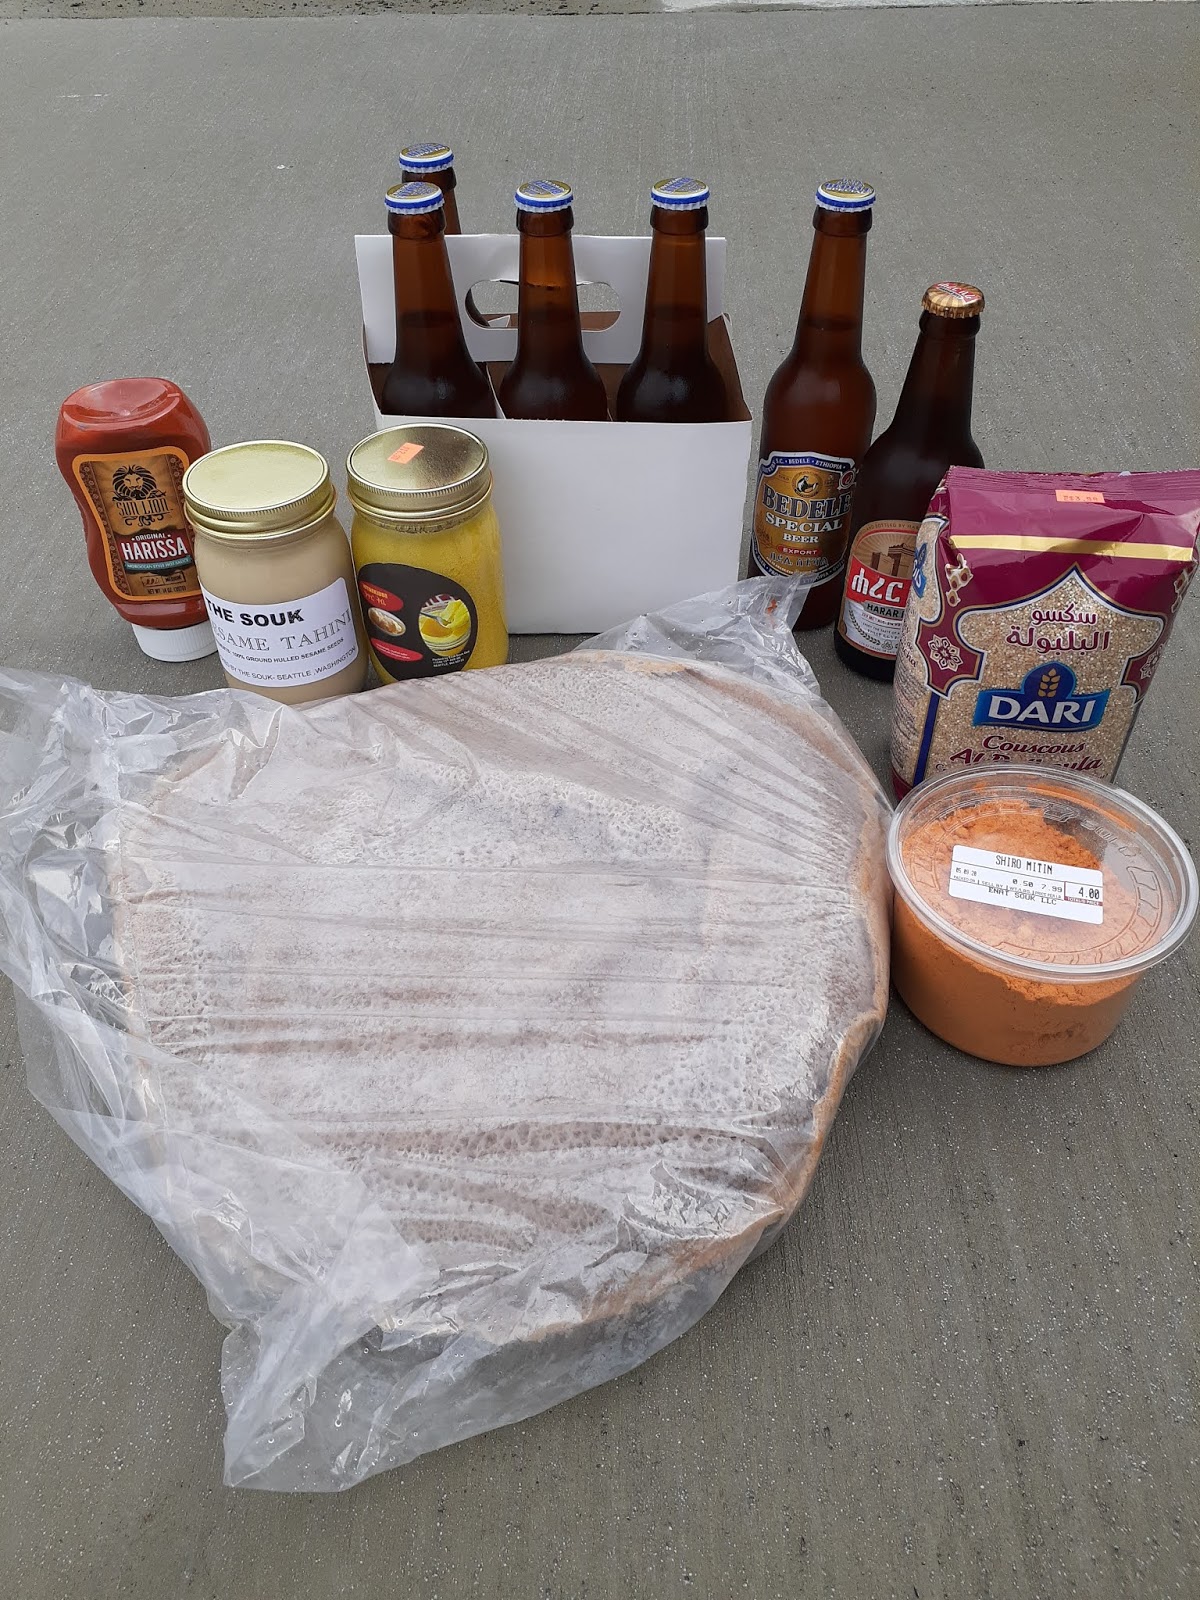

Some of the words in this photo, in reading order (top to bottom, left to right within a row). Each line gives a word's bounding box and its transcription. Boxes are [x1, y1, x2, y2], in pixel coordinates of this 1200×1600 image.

[762, 483, 851, 519] BEDELE
[765, 511, 843, 533] SPECIAL
[135, 532, 167, 541] ORIGINAL
[782, 532, 820, 543] BEER
[121, 537, 188, 560] HARISSA
[782, 547, 818, 556] EXPORT
[205, 596, 235, 623] THE
[239, 608, 305, 627] SOUK
[866, 603, 899, 618] HARAR
[1032, 602, 1097, 625] سكسو
[280, 608, 352, 650] TAHINI
[246, 655, 273, 663] GROUND
[273, 655, 300, 663] HULLED
[301, 647, 326, 659] SESAME
[327, 636, 344, 651] SEEDS
[1006, 625, 1111, 656] البلبولة
[238, 669, 251, 678] THE
[276, 670, 312, 681] SEATTLE
[988, 695, 1096, 724] DARI
[982, 735, 1086, 754] Couscous
[995, 855, 1022, 869] SHIRO
[1026, 860, 1053, 875] MITIN
[988, 886, 1009, 896] ENAT
[1014, 891, 1036, 902] SOUK
[1041, 897, 1057, 906] LLC
[1041, 883, 1063, 893] 7.99
[1078, 886, 1100, 900] 4.00
